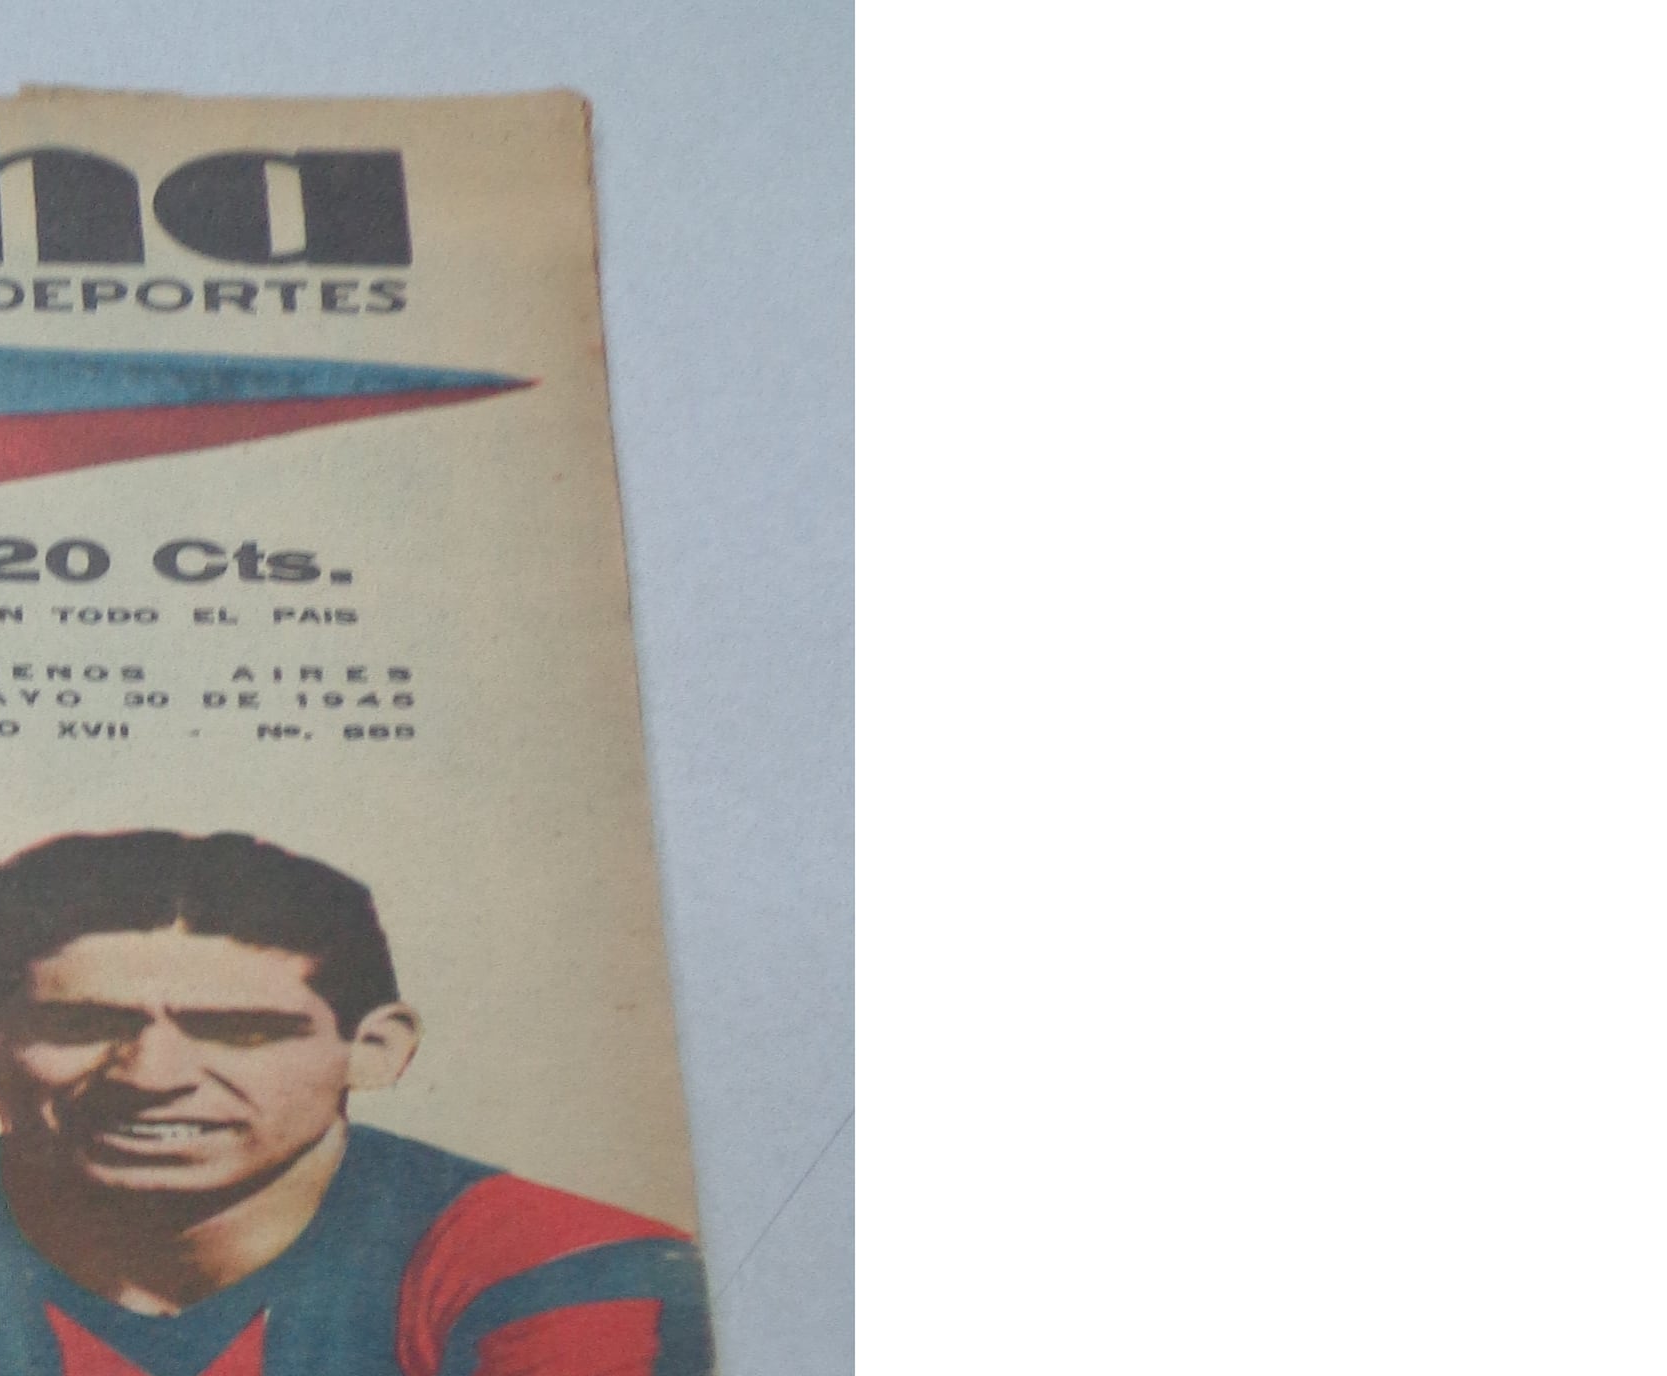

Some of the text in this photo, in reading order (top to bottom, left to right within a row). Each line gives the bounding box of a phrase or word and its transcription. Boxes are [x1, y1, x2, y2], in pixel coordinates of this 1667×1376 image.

[152, 538, 353, 585] Cts.
[52, 607, 159, 625] TODO
[193, 607, 238, 625] EL
[273, 607, 359, 625] PAIS
[232, 665, 412, 684] AIRES
[124, 691, 169, 708] 30
[202, 691, 259, 709] DE
[58, 721, 129, 740] XVII
